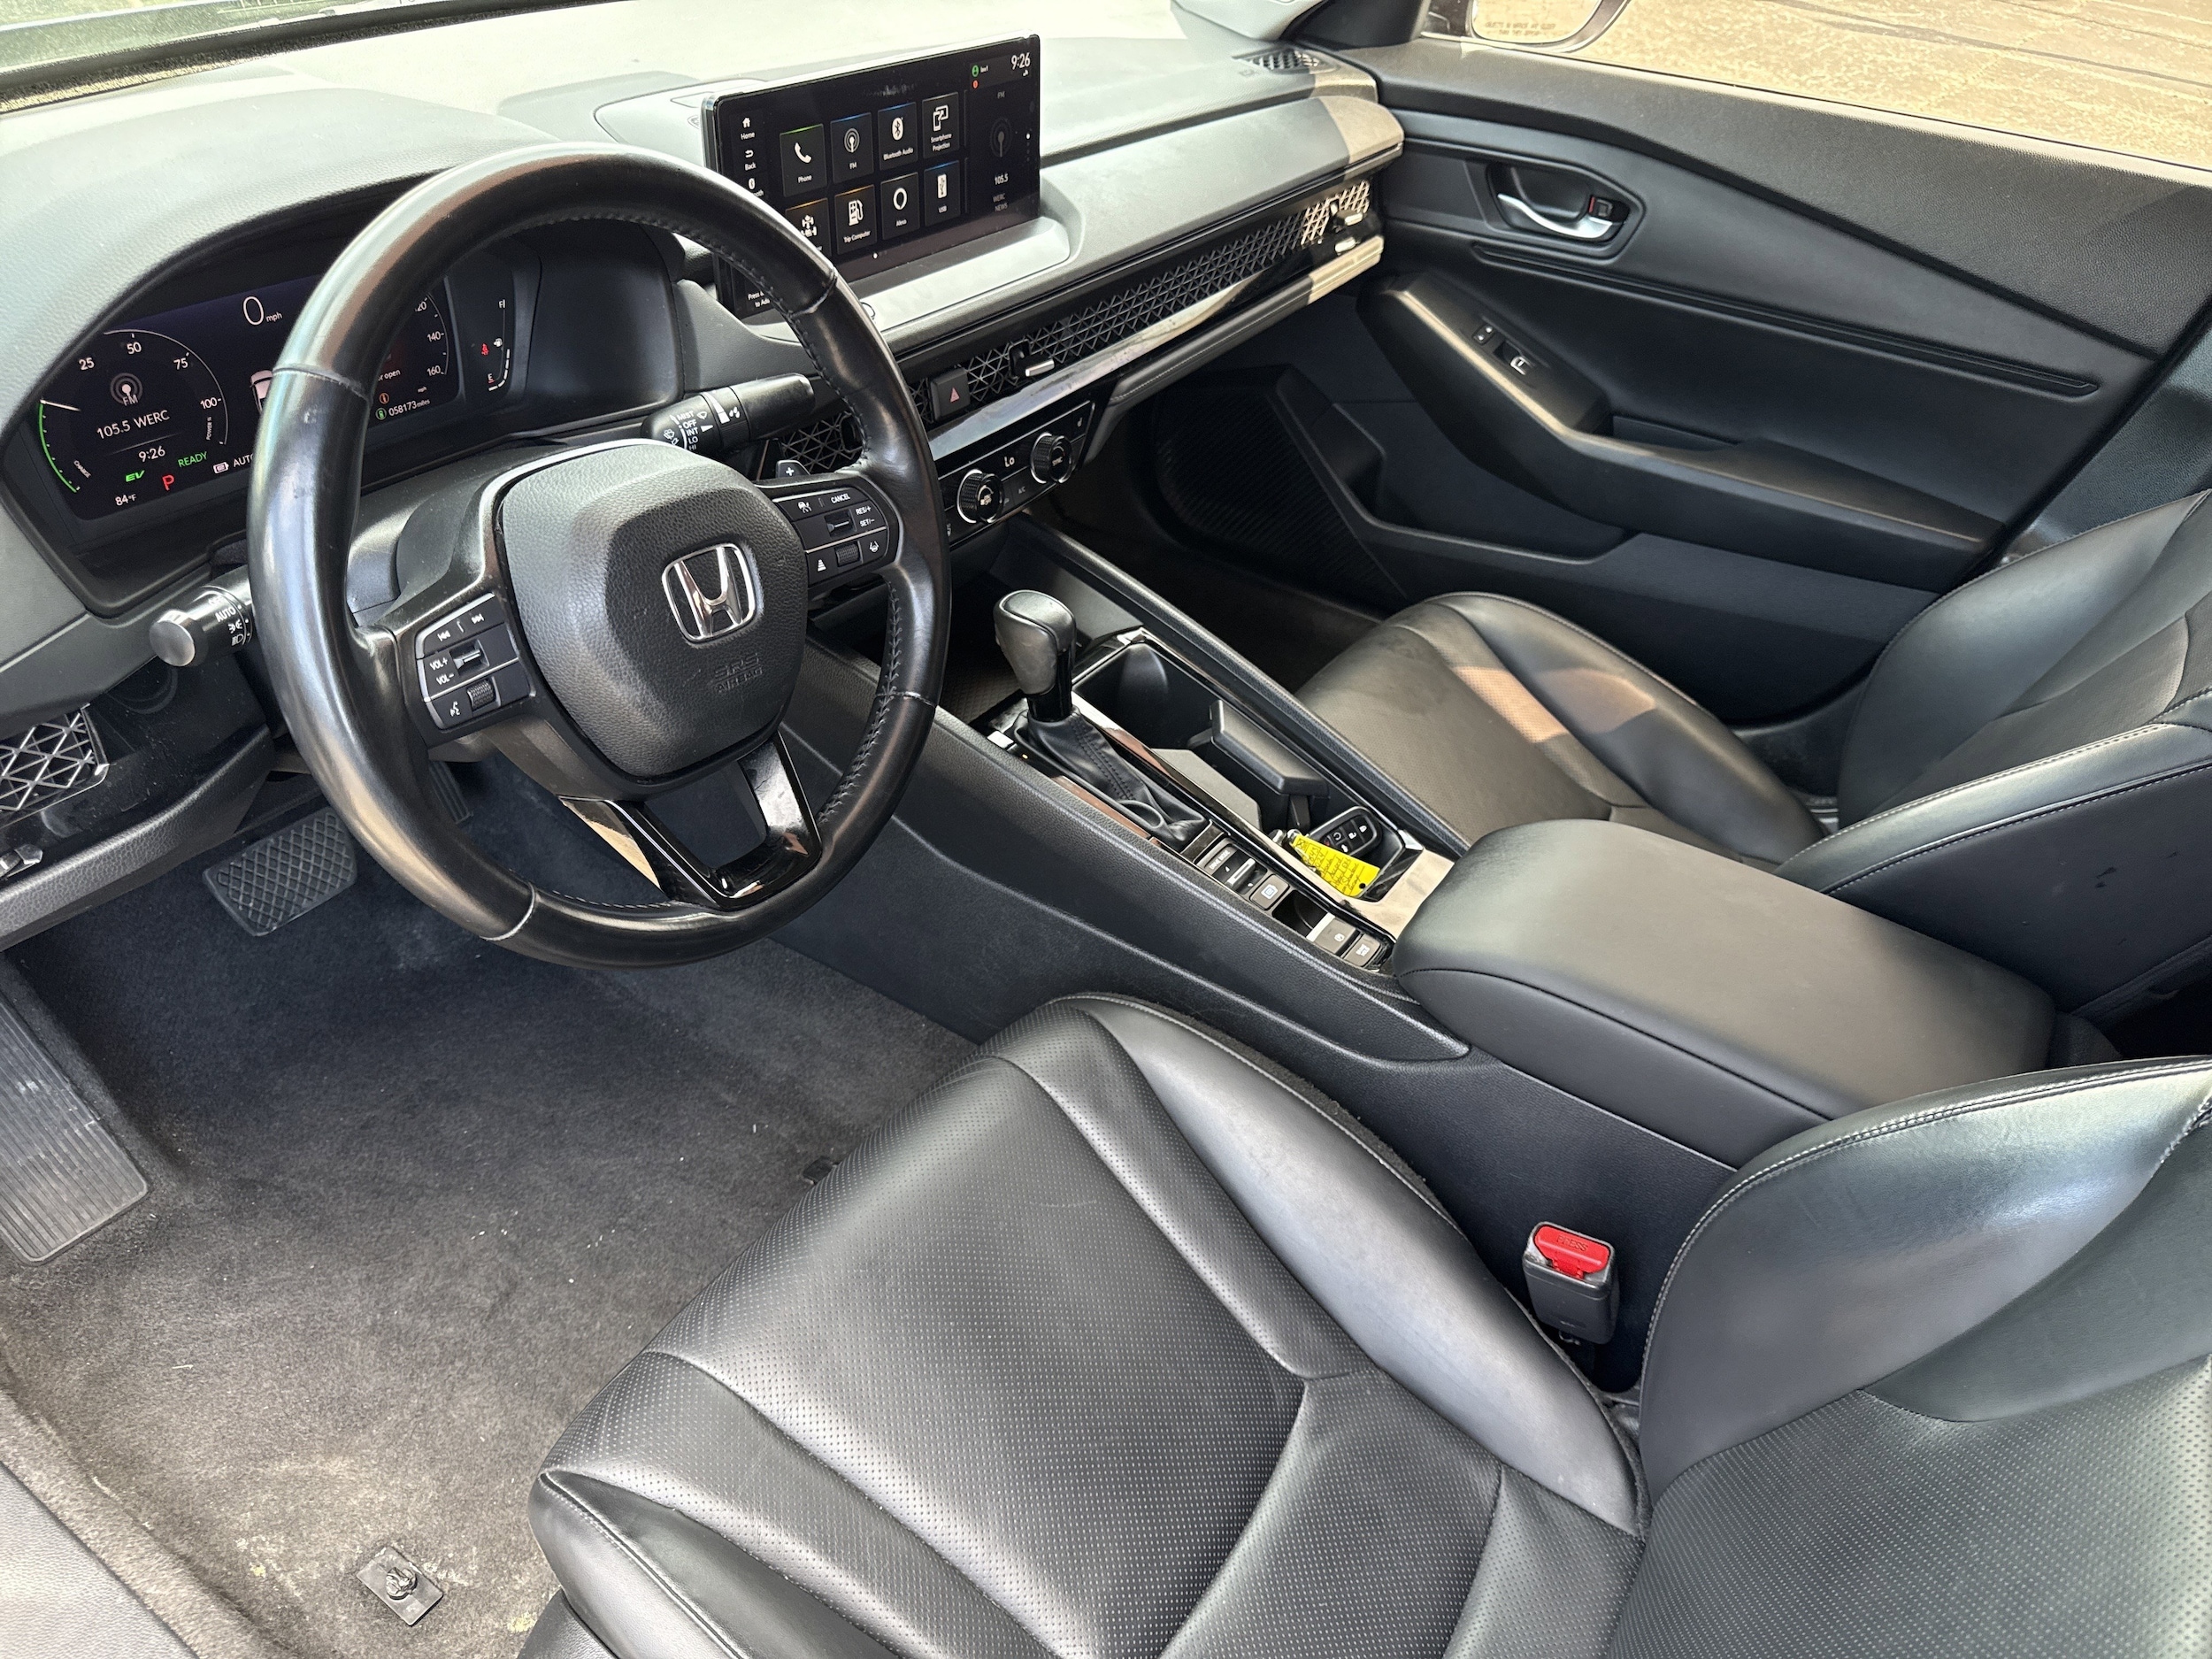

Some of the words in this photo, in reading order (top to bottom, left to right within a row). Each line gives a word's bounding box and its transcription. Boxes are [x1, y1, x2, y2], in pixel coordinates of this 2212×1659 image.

[1011, 52, 1031, 70] 9:26
[931, 134, 952, 143] Smartphone
[933, 142, 950, 151] Projection
[883, 150, 902, 160] Bluetooth
[744, 162, 757, 171] Back
[995, 173, 1009, 185] 105.5
[852, 230, 871, 242] Computer
[243, 296, 264, 325] 0
[266, 311, 282, 323] mph
[427, 331, 442, 343] 140
[127, 342, 142, 355] 50
[79, 357, 95, 371] 25
[173, 357, 188, 370] 75
[384, 370, 401, 380] open
[426, 365, 441, 376] 160
[123, 395, 138, 406] FM
[200, 396, 217, 410] 100
[388, 400, 417, 417] 058173
[417, 399, 430, 408] miles
[676, 411, 695, 421] MIST
[97, 421, 130, 440] 105.5
[134, 410, 170, 429] WERC
[682, 420, 697, 429] OFF
[139, 446, 165, 462] 9:26
[178, 451, 208, 467] READY
[126, 470, 144, 482] EV
[163, 474, 175, 490] P
[830, 493, 850, 504] CANCEL
[215, 606, 236, 622] AUTO
[716, 653, 759, 679] SRS
[1556, 1235, 1587, 1251] PRESS
